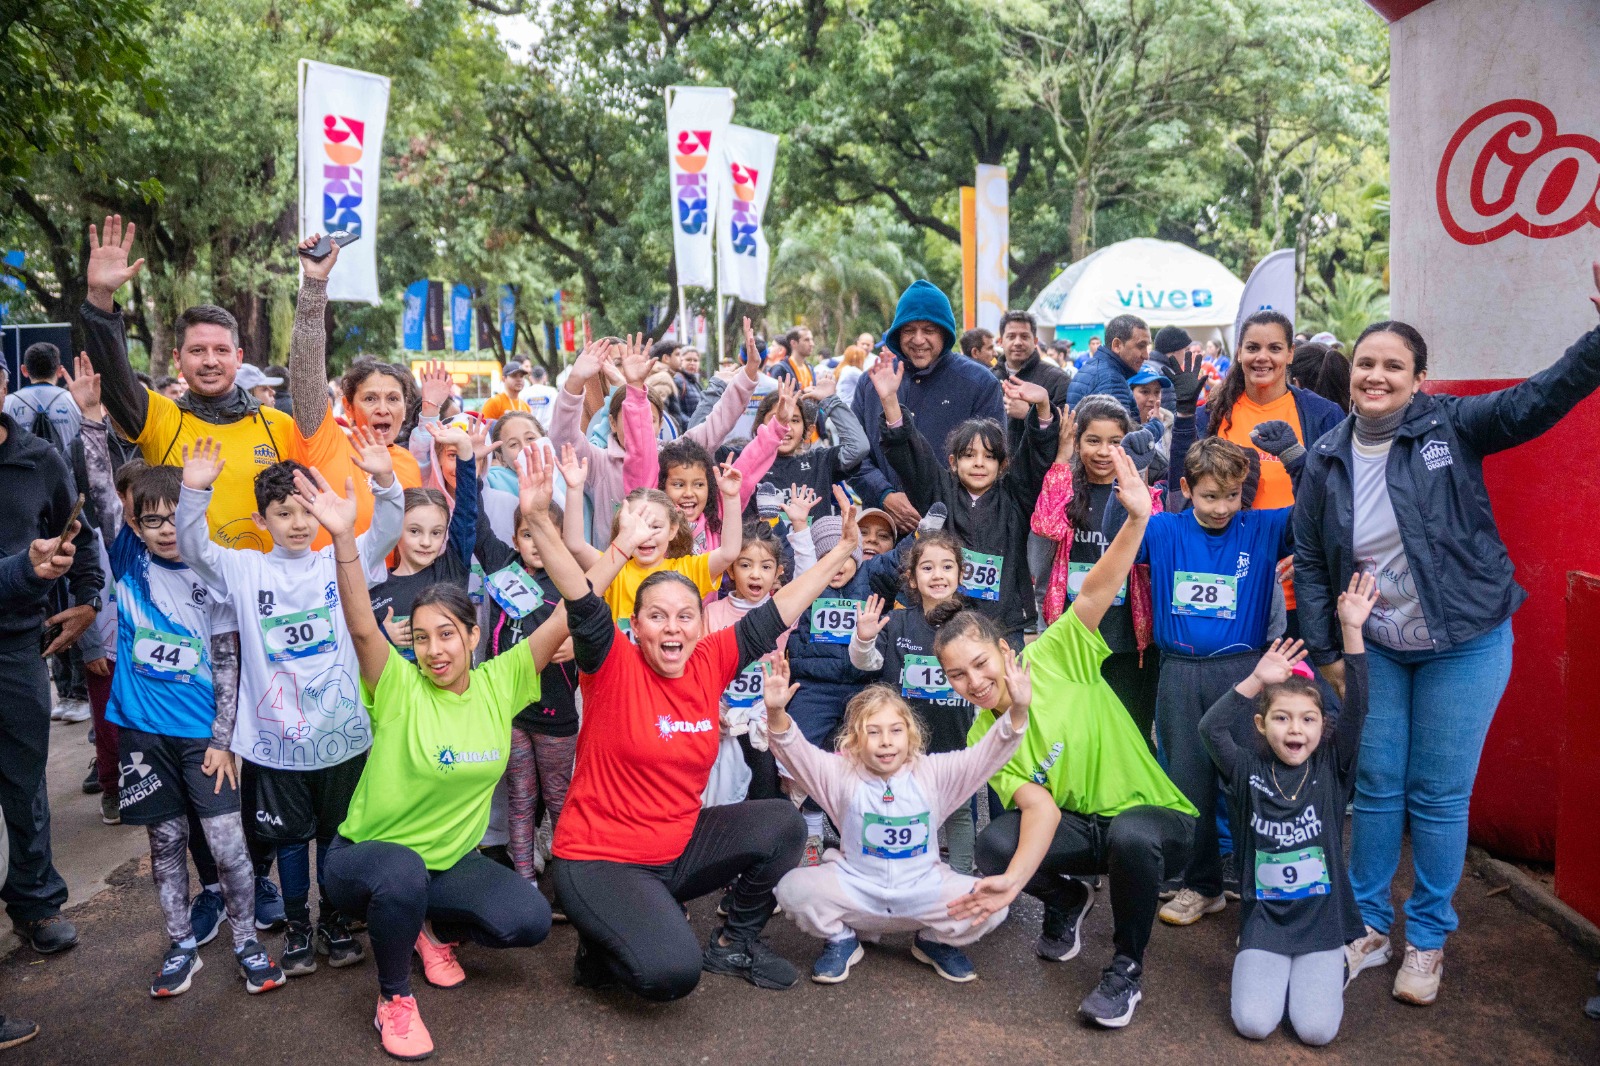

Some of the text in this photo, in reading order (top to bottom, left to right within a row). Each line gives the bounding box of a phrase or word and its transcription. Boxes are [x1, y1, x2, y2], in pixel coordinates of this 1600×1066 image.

[1436, 99, 1600, 245] Co
[504, 579, 529, 599] 17
[1190, 584, 1218, 604] 28
[817, 610, 858, 630] 195
[284, 623, 314, 646] 30
[150, 644, 181, 667] 44
[729, 673, 763, 694] 58
[921, 667, 948, 686] 13
[252, 716, 369, 767] años
[883, 827, 912, 846] 39
[1282, 865, 1298, 884] 9
